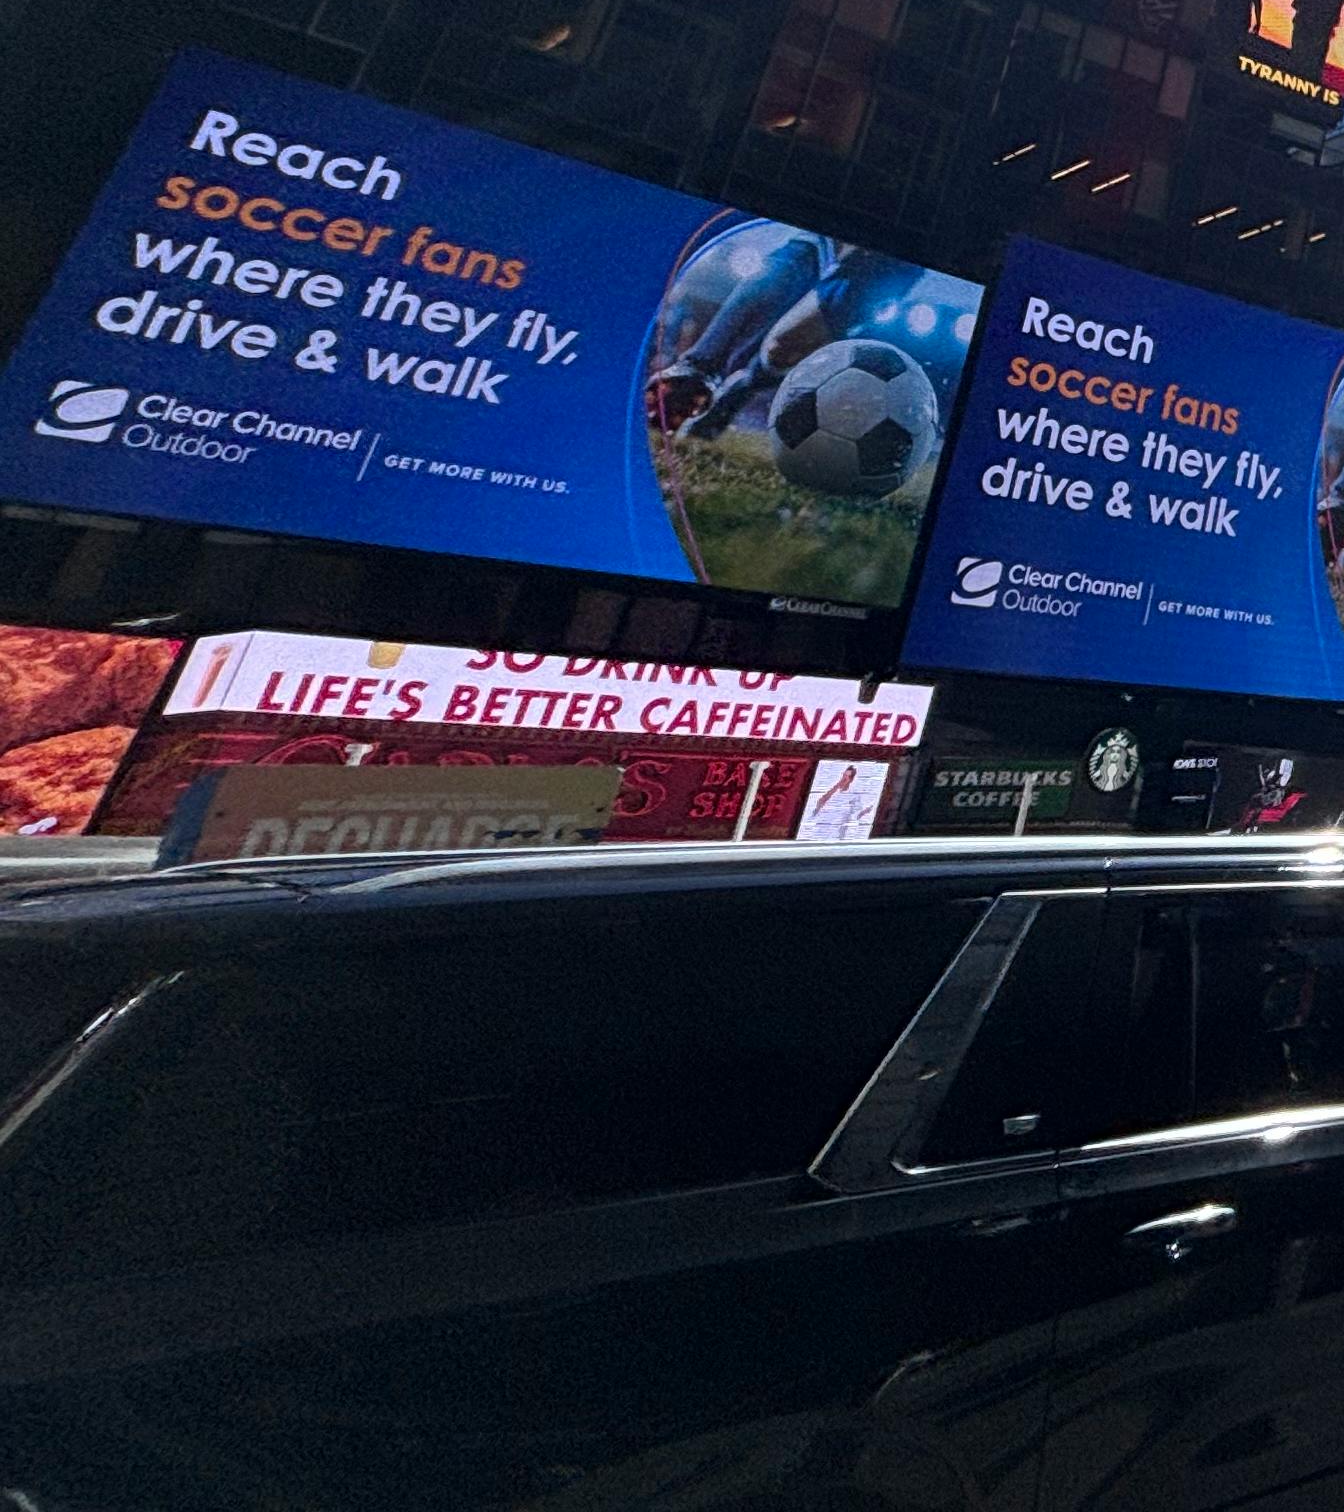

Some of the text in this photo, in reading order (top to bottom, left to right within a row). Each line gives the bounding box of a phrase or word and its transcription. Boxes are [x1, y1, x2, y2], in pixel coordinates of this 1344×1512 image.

[1238, 55, 1341, 105] TYRANNY IS
[190, 109, 403, 201] Reach
[156, 172, 528, 291] soccer fans
[134, 231, 581, 366] where they fly,
[1021, 296, 1155, 364] Reach
[95, 288, 511, 405] drive & walk
[138, 392, 363, 453] Clear Channel
[1007, 355, 1240, 436] soccer fans
[123, 422, 257, 466] Outdoor
[383, 453, 571, 495] GET MORE WITH US.
[997, 407, 1285, 500] where they fly,
[981, 457, 1241, 538] drive & walk
[1002, 586, 1084, 618] Outdoor
[1009, 563, 1144, 602] Clear Channel
[1158, 600, 1275, 626] GET MORE WITH US.
[255, 670, 917, 745] LIFE'S BETTER CAFFEINATED
[934, 769, 1073, 788] STARBUCKS
